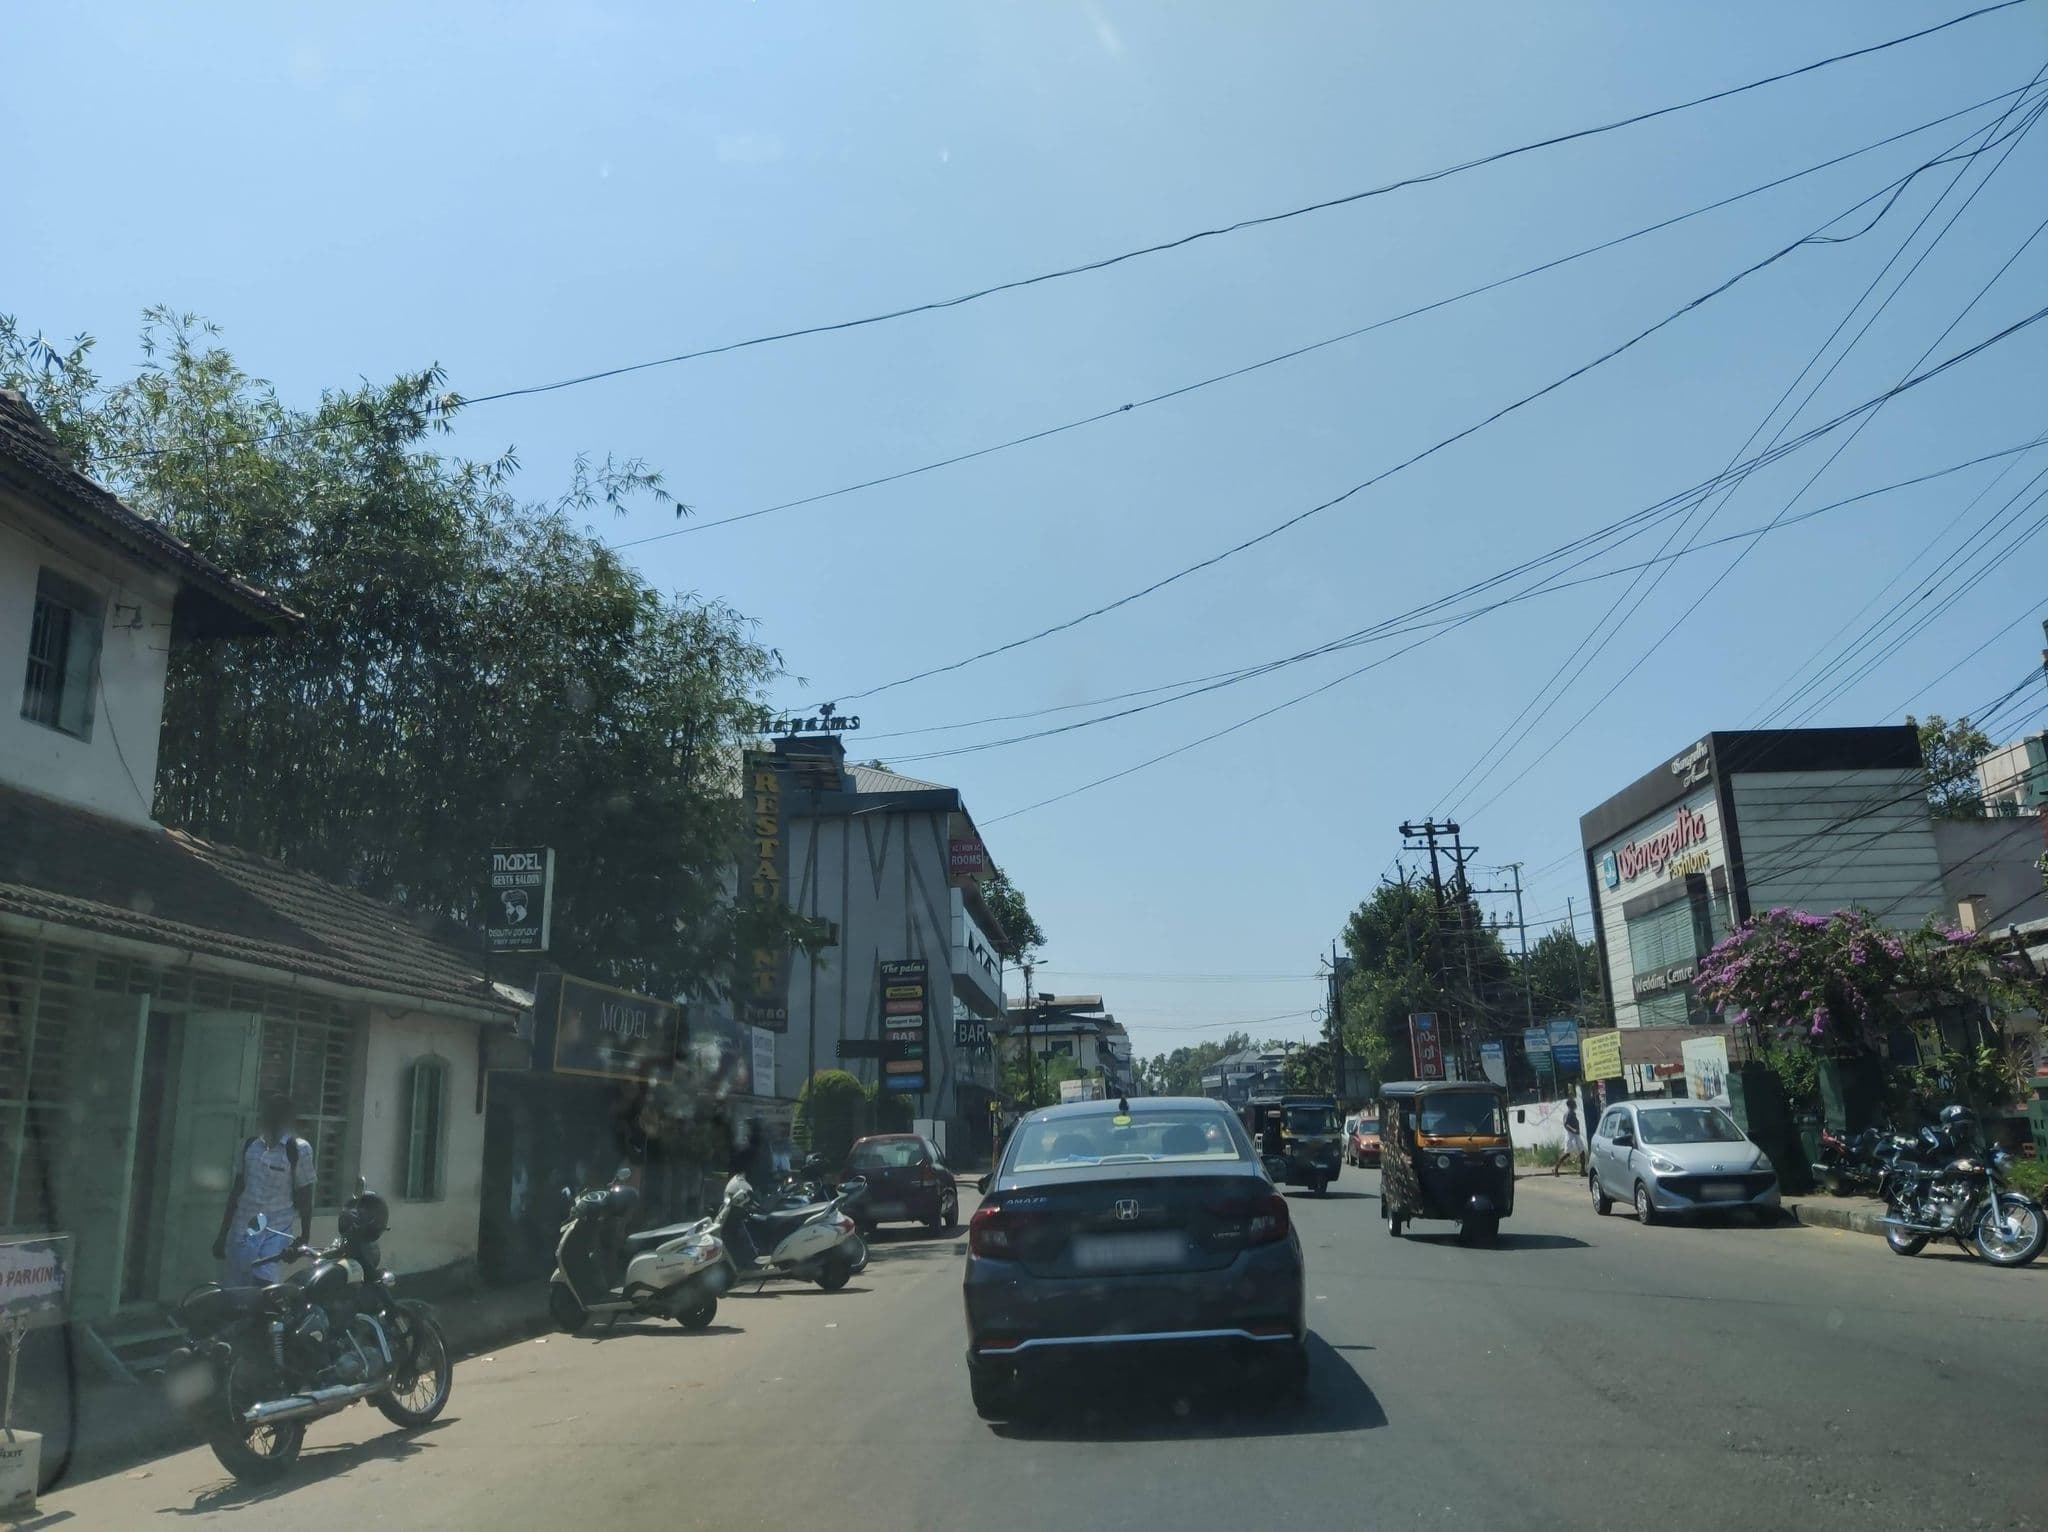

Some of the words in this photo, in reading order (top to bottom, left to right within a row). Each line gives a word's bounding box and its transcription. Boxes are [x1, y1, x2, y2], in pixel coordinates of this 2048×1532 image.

[759, 718, 786, 733] he
[791, 715, 860, 735] palms
[1616, 806, 1706, 879] Sangeetha
[493, 854, 542, 871] MODEL
[952, 856, 981, 865] ROOMS
[1668, 849, 1710, 879] Fashions
[494, 875, 514, 885] GENTS
[752, 771, 779, 993] RESTAUNT
[882, 964, 898, 974] The
[899, 962, 925, 975] palms
[1634, 974, 1666, 993] Wedding
[1667, 966, 1694, 983] Centre
[599, 1000, 649, 1040] MODEL
[892, 1031, 916, 1041] BAR
[959, 1023, 985, 1042] BAR
[1006, 1196, 1047, 1206] AMAZE
